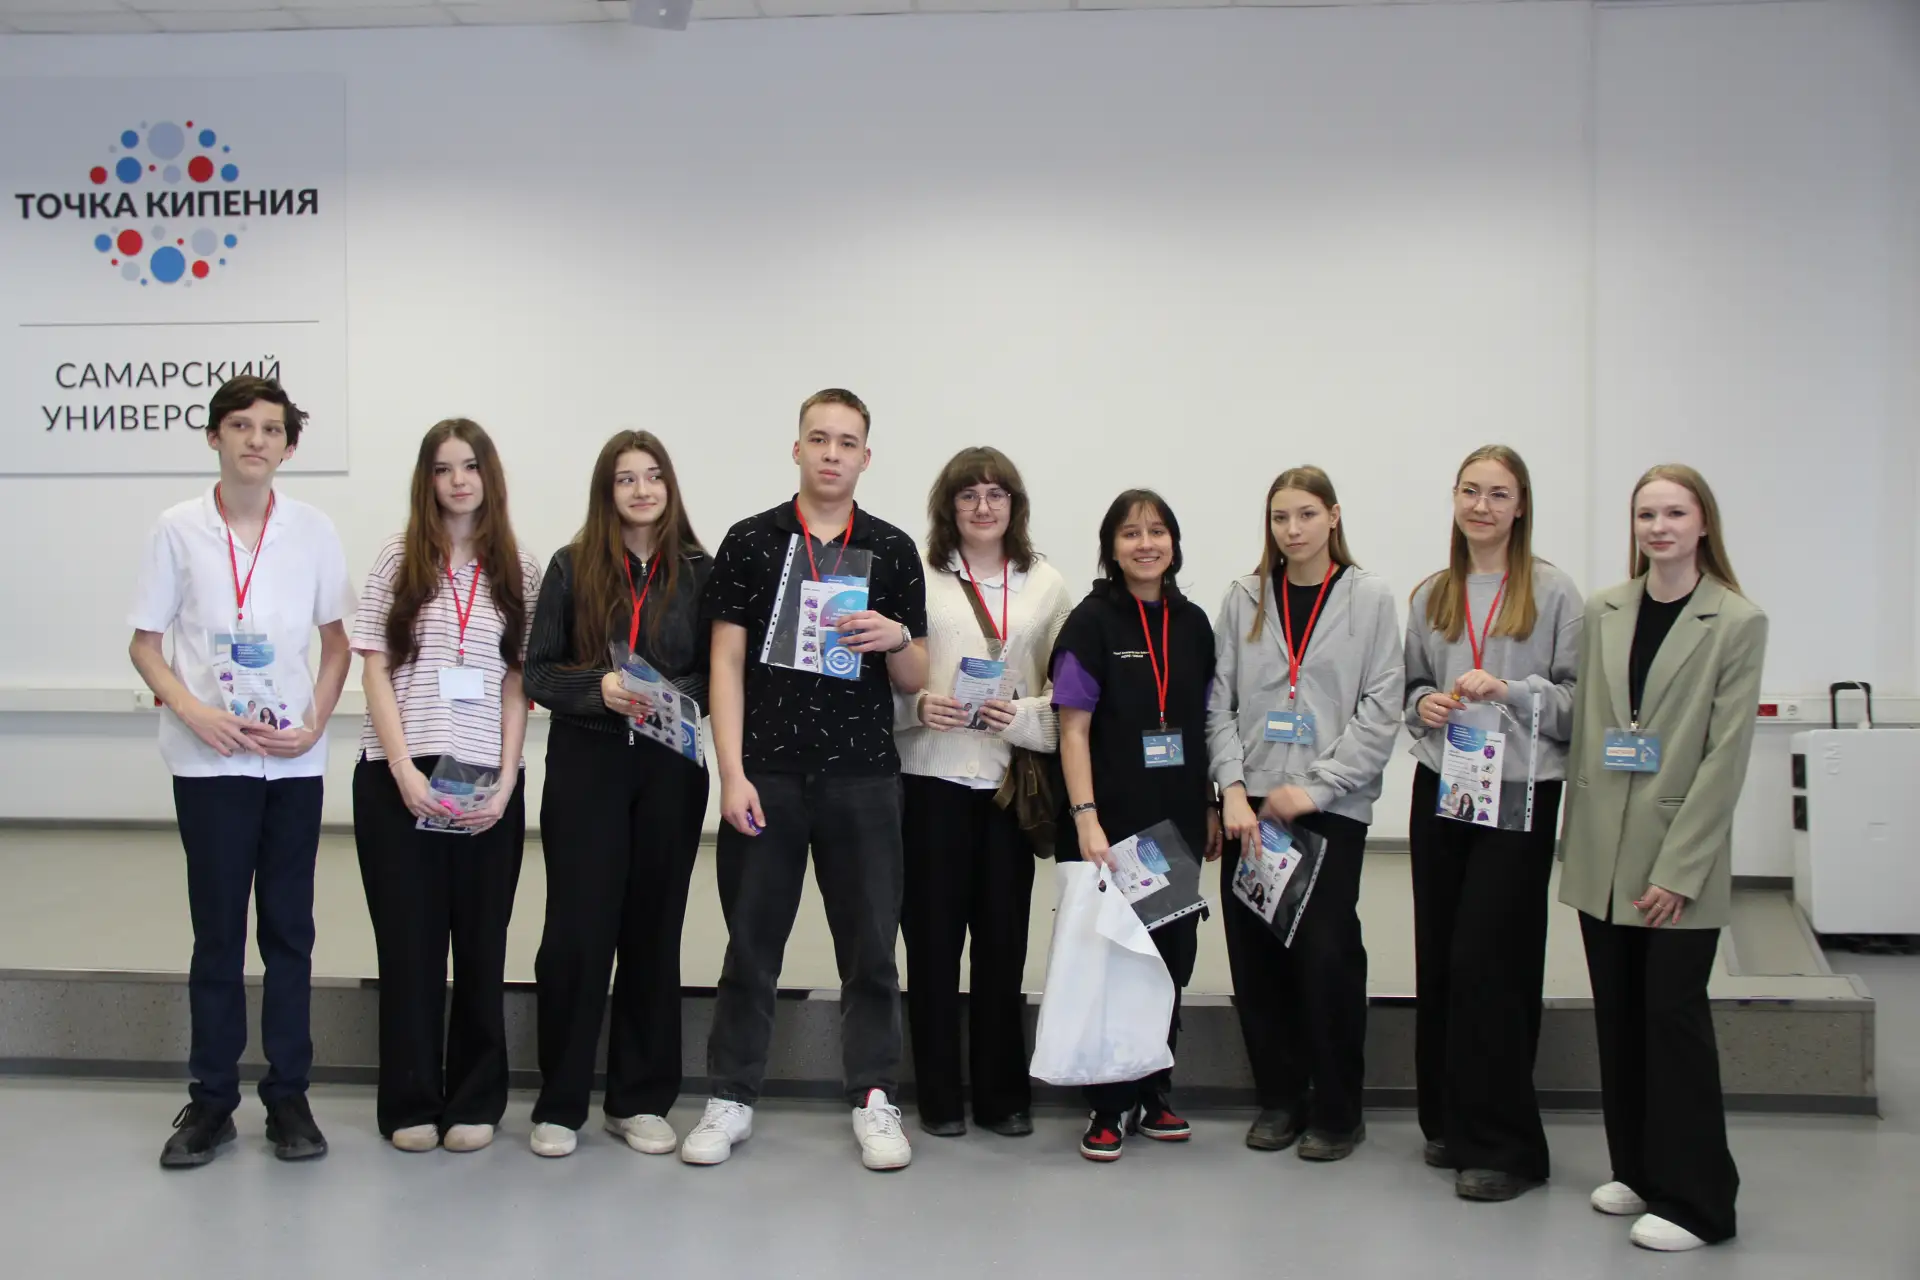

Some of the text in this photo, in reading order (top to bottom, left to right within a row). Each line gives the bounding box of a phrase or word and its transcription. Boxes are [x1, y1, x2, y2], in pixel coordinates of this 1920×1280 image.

[15, 188, 319, 219] ТОЧКА КИПЕНИЯ
[42, 404, 207, 434] УНИВЕРС
